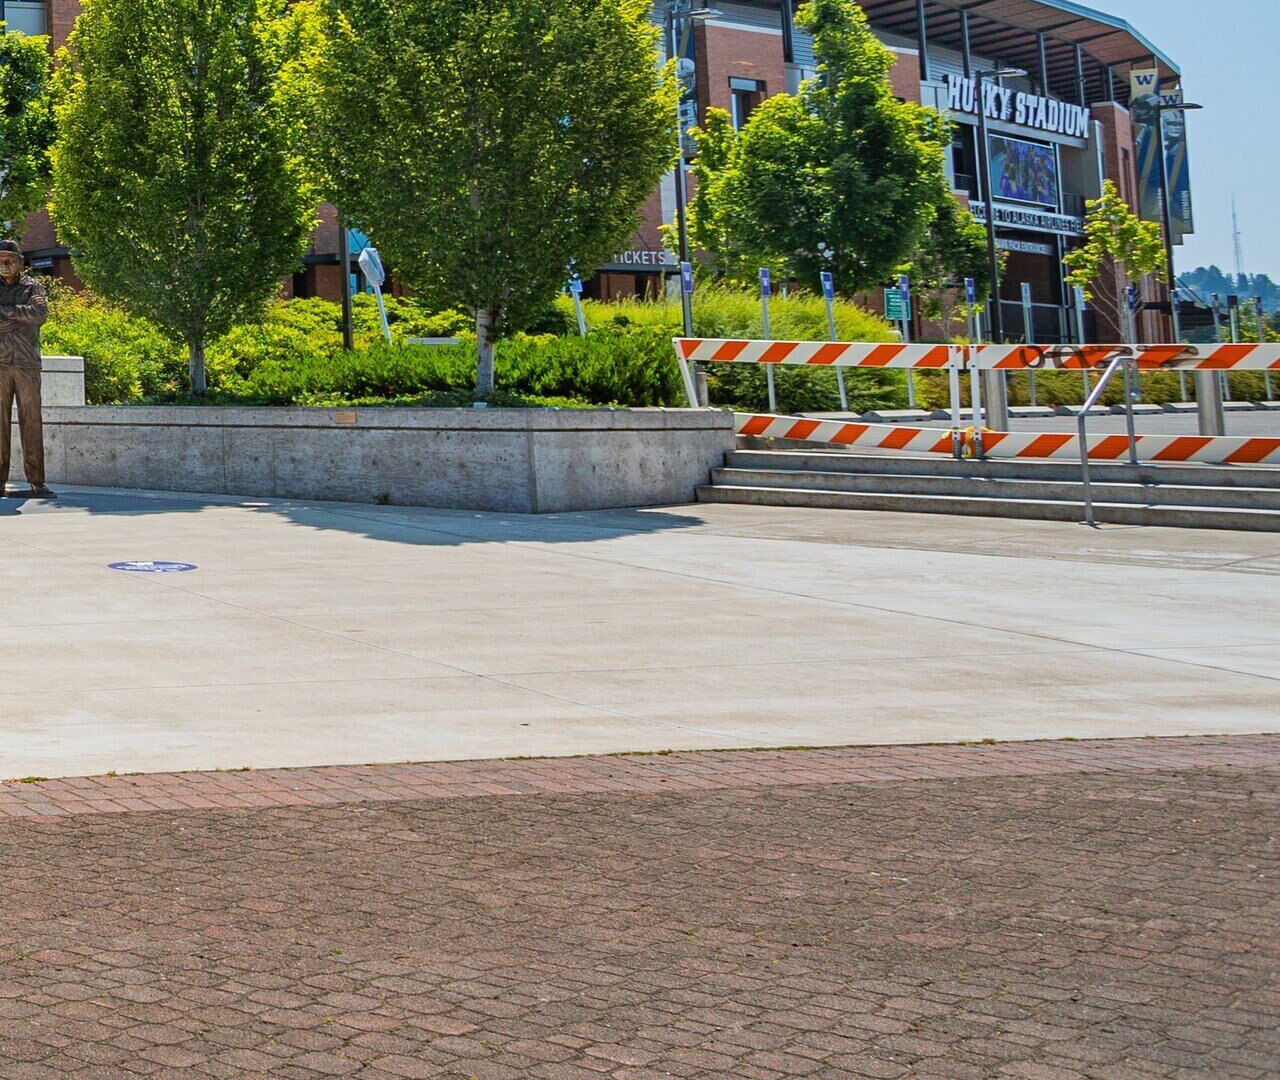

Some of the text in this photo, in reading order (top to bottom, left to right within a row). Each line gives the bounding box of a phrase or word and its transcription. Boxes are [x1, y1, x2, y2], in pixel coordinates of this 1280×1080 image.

[1134, 74, 1154, 86] W
[1161, 94, 1180, 106] W
[1015, 91, 1091, 138] STADIUM
